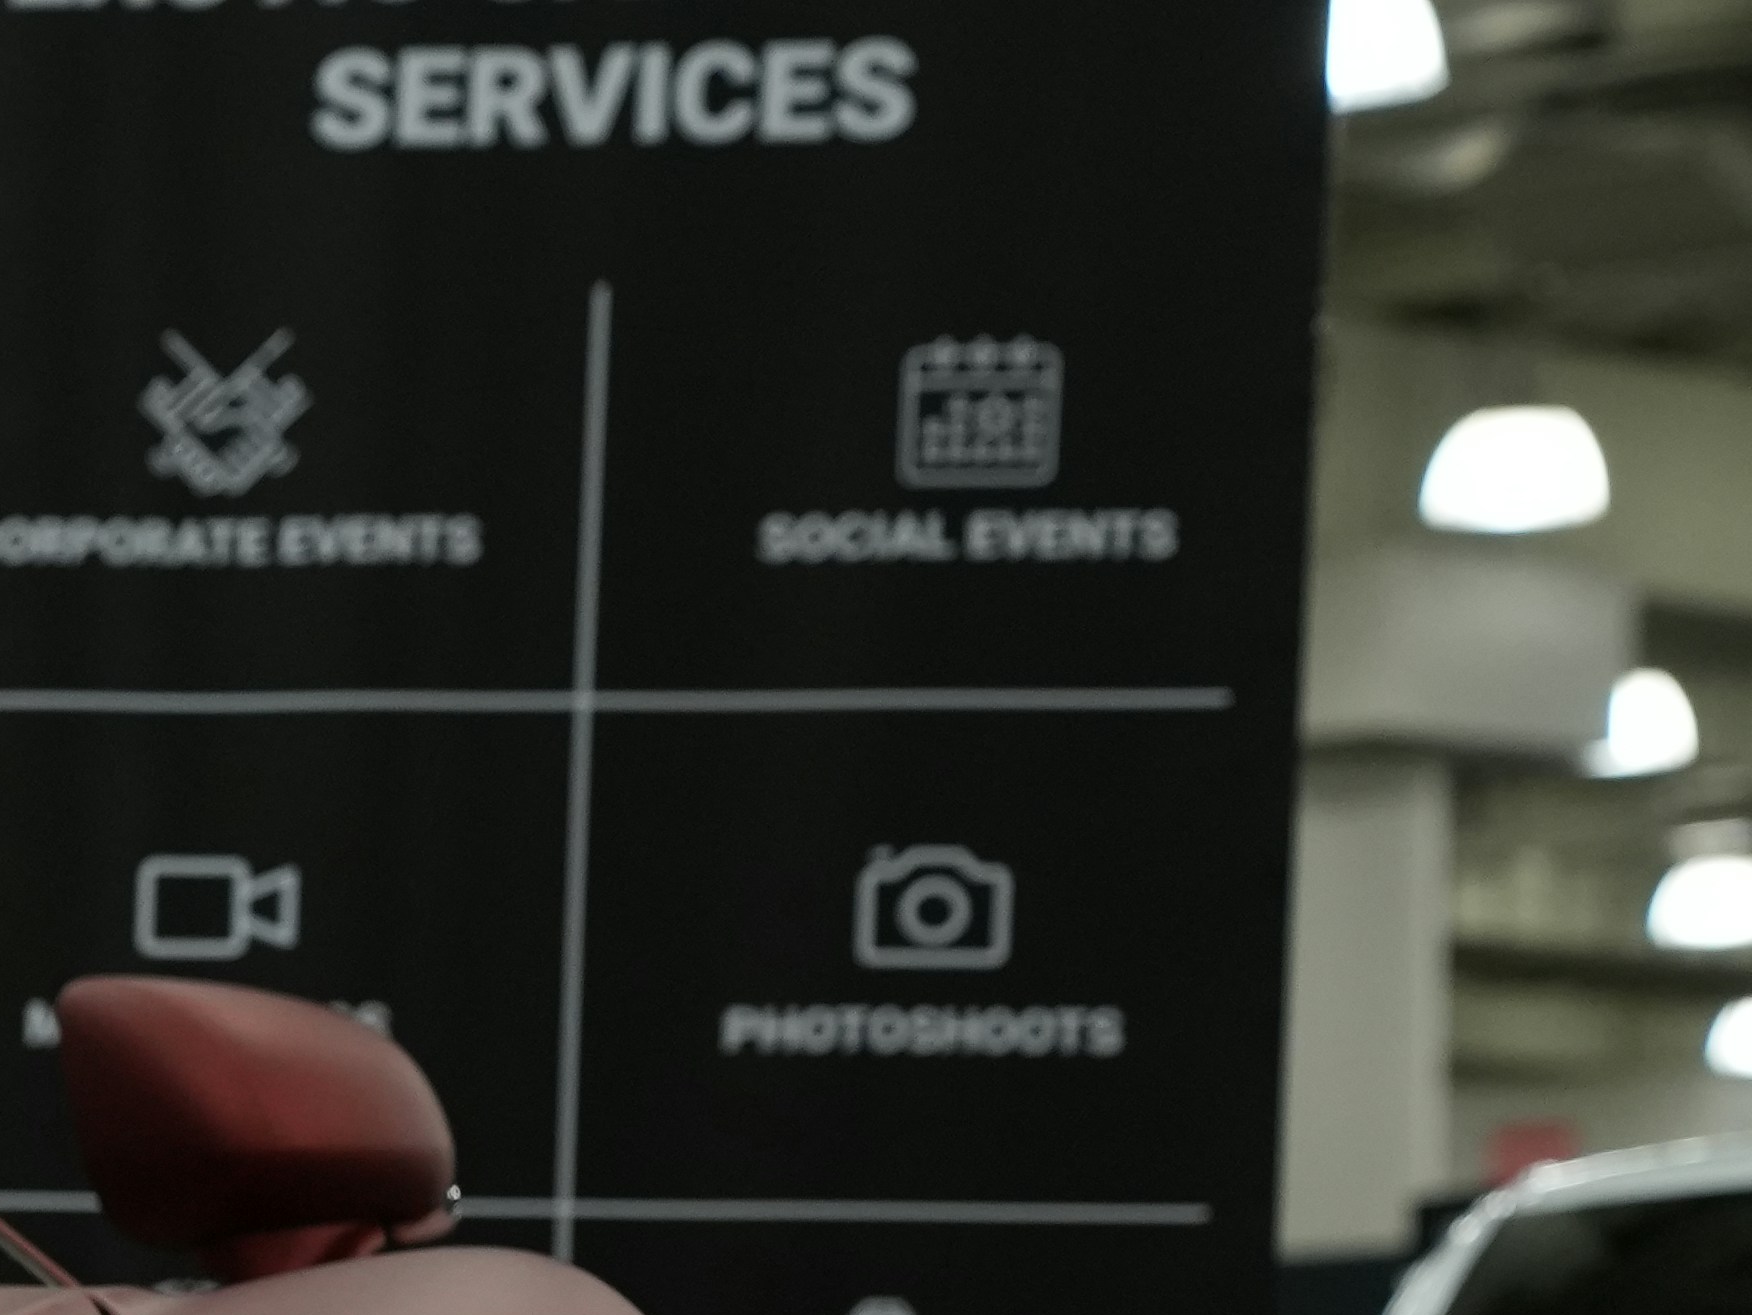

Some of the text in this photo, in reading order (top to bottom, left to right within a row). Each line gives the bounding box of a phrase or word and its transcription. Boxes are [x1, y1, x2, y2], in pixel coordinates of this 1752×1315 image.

[311, 37, 918, 150] SERVICES
[277, 513, 483, 566] EVENTS
[756, 509, 1178, 566] SOCIAL EVENTS
[718, 1005, 1125, 1057] PHOTOSHOOTS
